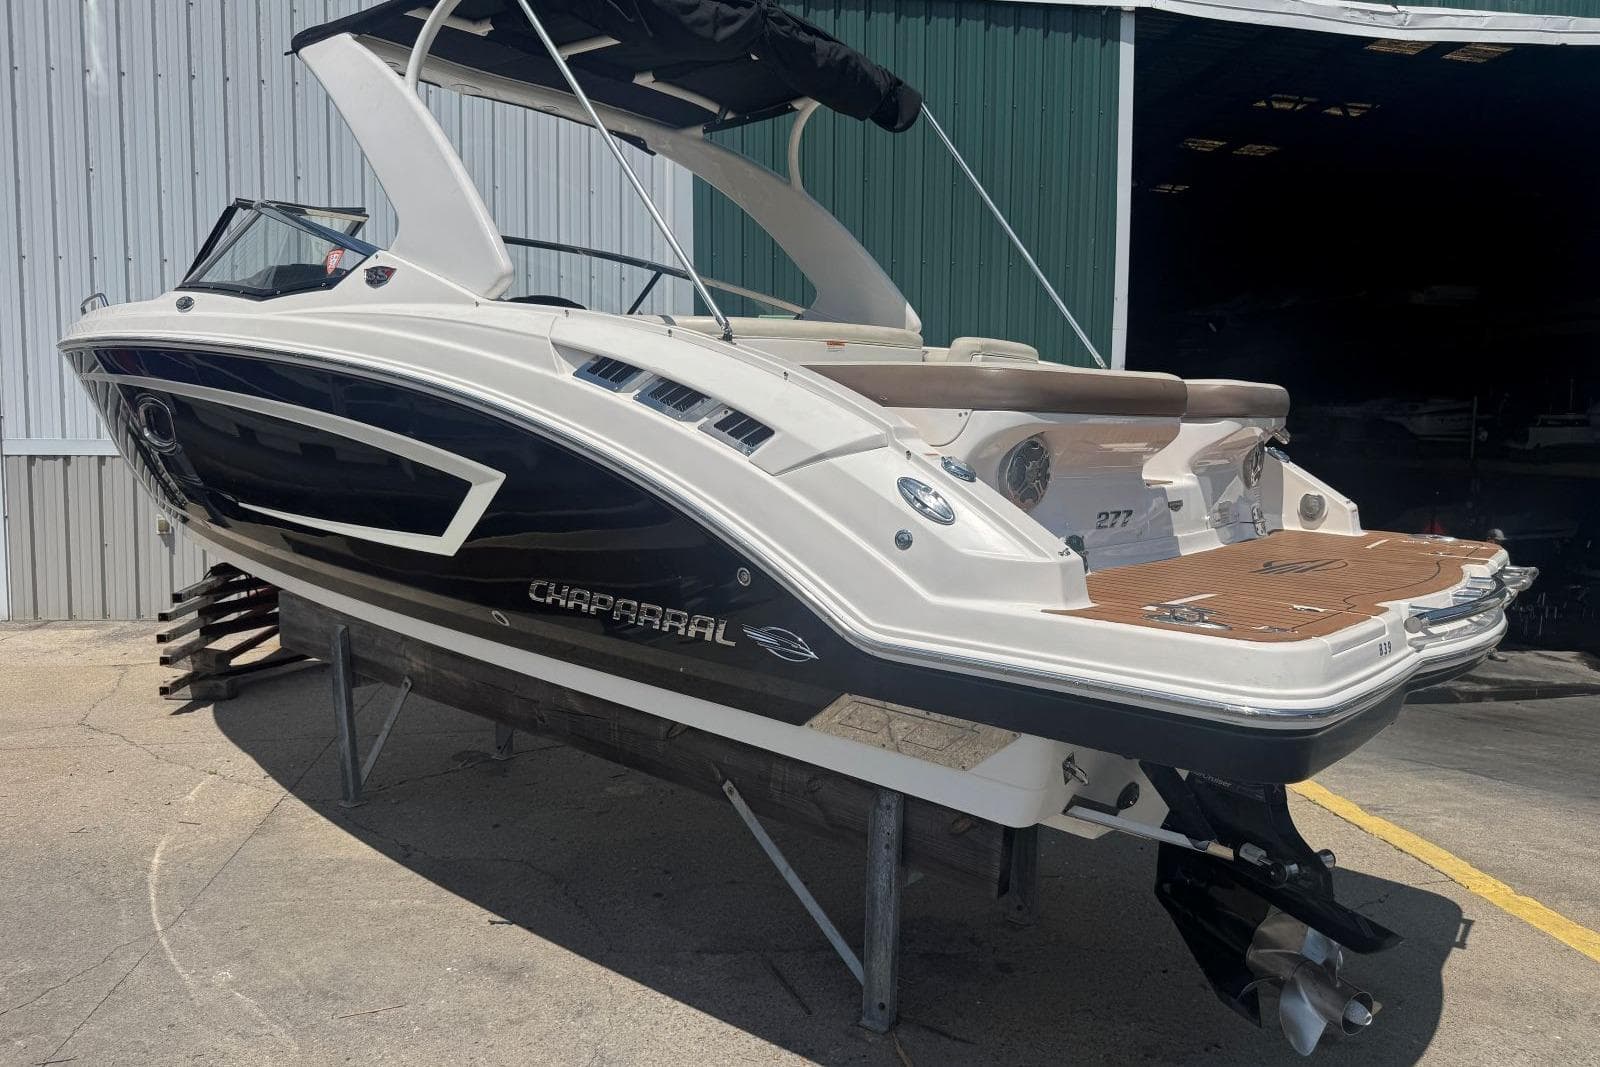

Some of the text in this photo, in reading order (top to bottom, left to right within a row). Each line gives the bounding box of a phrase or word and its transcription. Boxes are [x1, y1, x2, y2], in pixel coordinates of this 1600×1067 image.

[1095, 509, 1134, 529] 277
[528, 579, 736, 647] CHAPARRAL
[1378, 640, 1392, 656] 839
